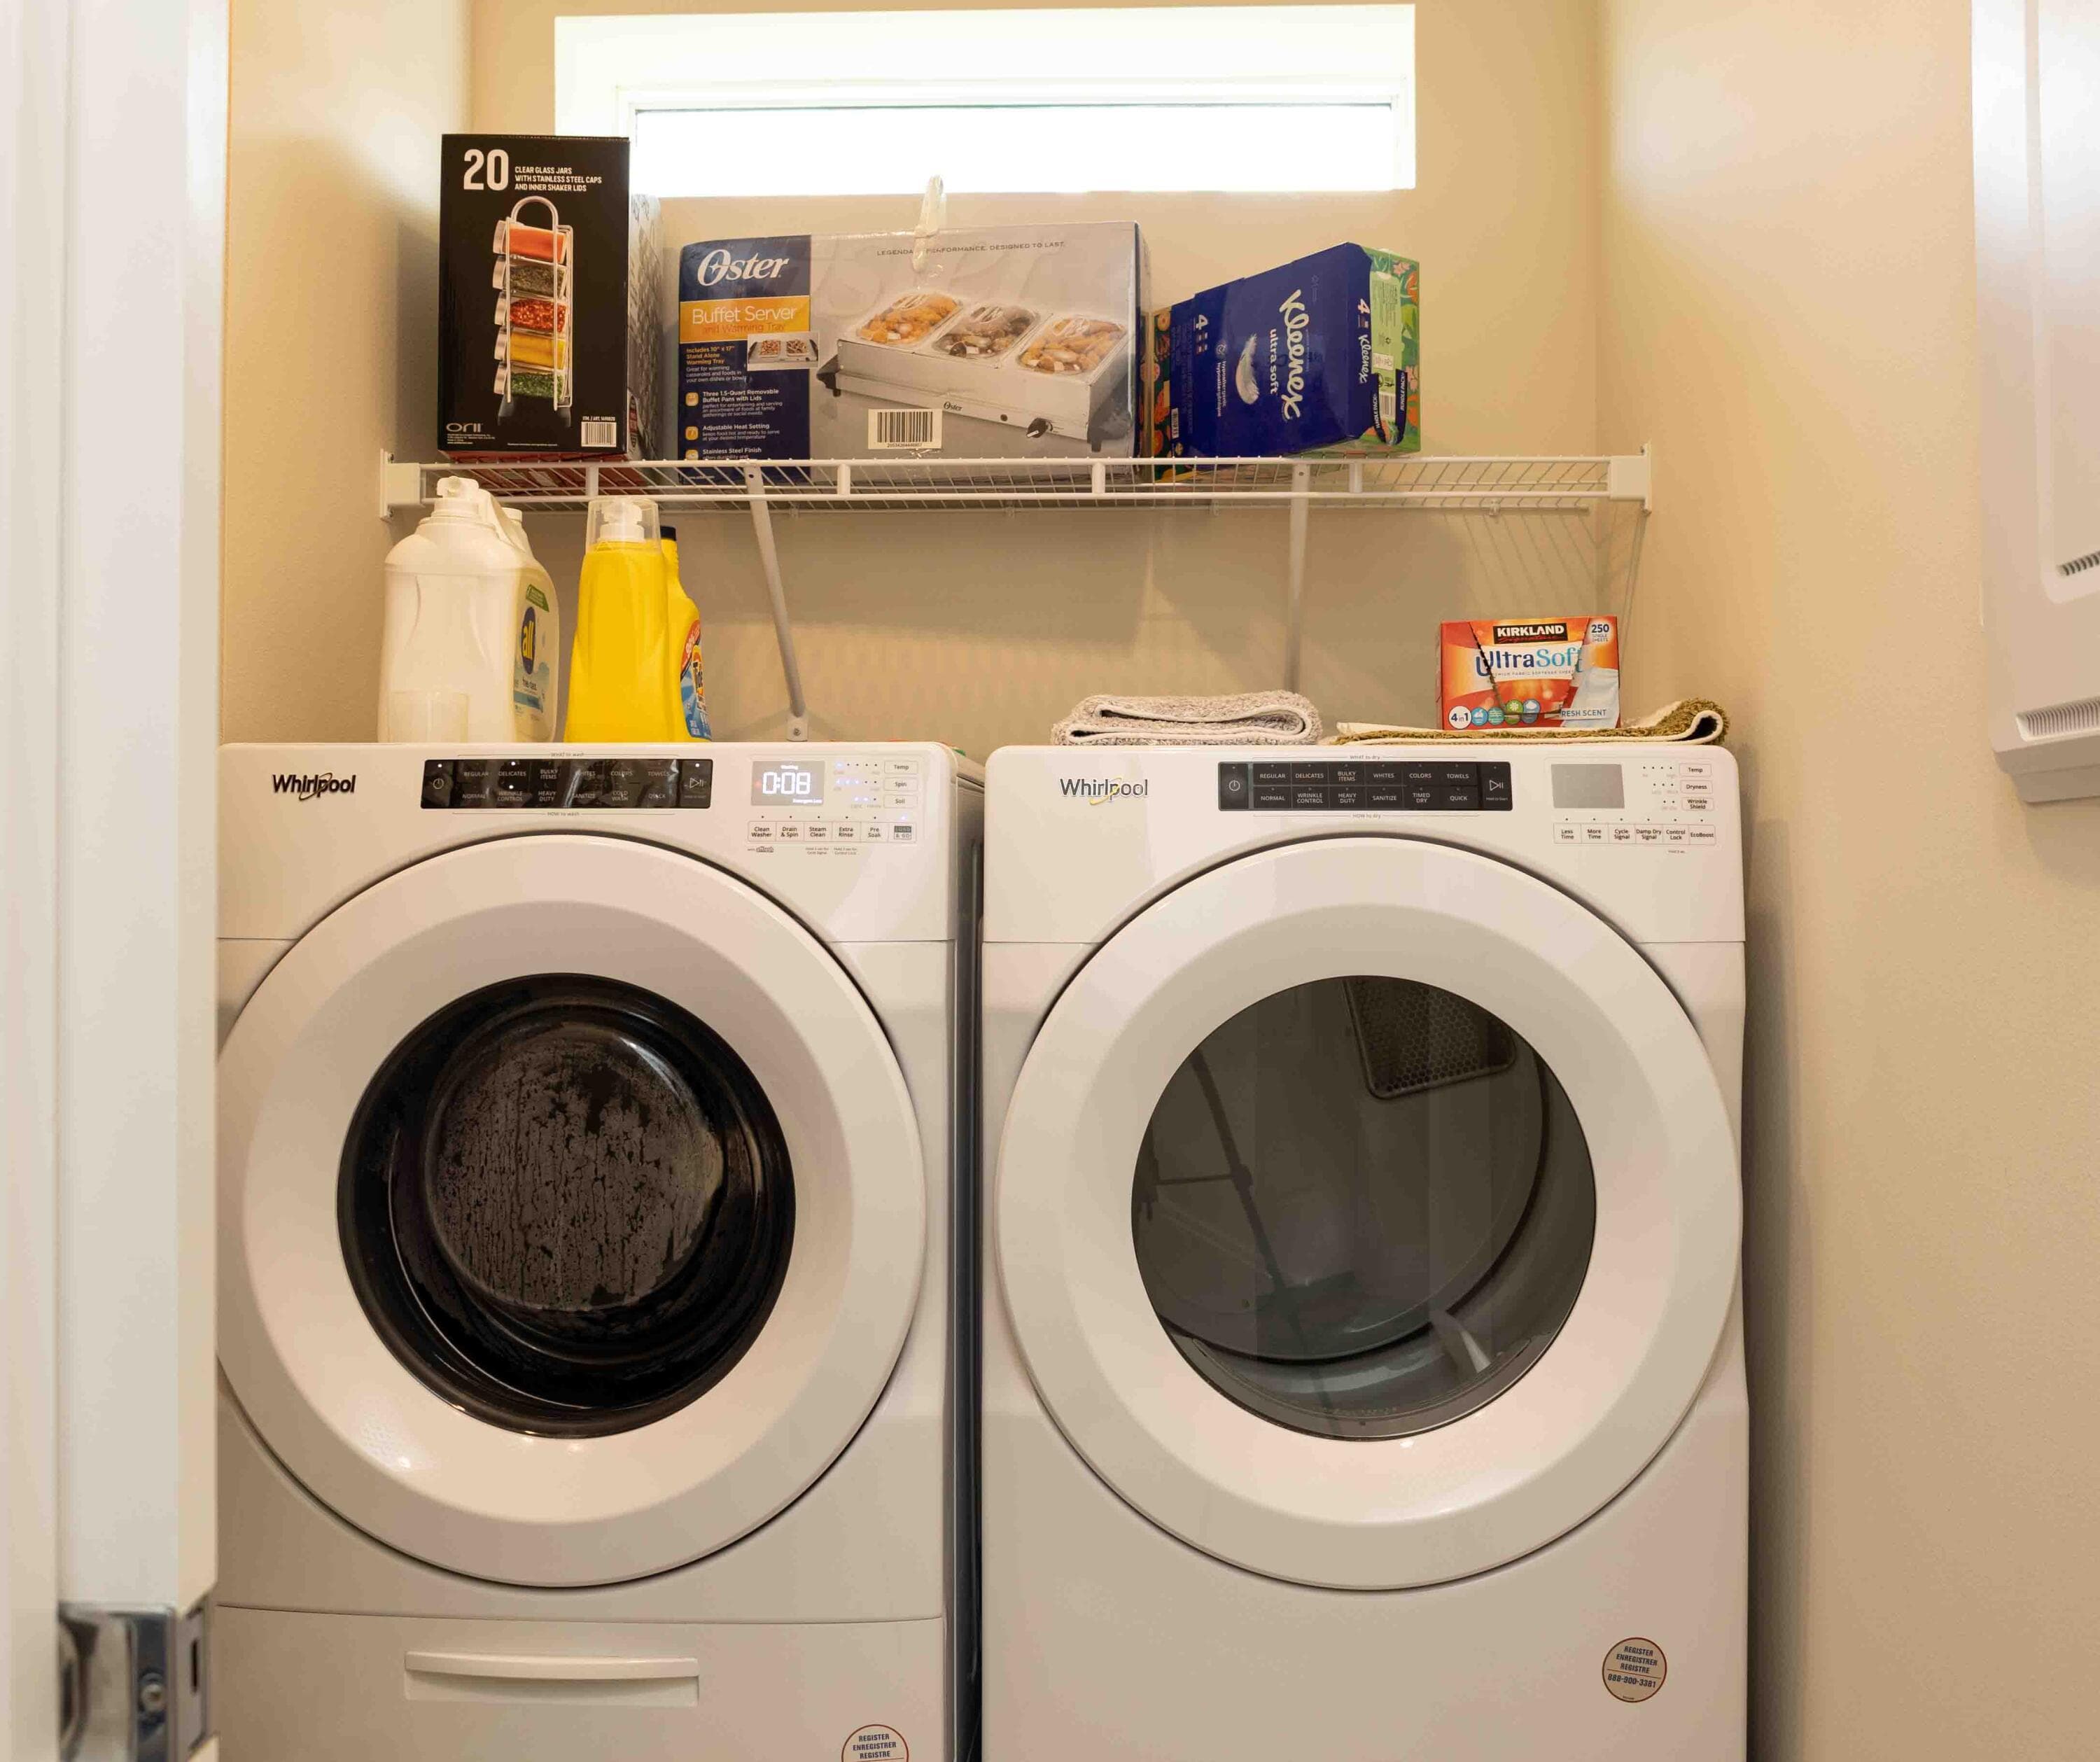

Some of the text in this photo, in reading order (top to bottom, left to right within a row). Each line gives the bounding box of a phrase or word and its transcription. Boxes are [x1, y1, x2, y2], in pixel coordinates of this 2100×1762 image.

[463, 148, 509, 190] 20
[697, 249, 790, 286] Oster
[1357, 298, 1371, 314] 4
[692, 306, 797, 324] Buffet Server
[1196, 314, 1208, 330] 4
[722, 324, 764, 335] Warming
[1269, 328, 1280, 395] ultra soft
[1279, 289, 1310, 420] Kleenex
[1358, 335, 1371, 384] Kleenex
[943, 401, 963, 412] Oster
[1497, 625, 1564, 637] KIRKLAND
[1591, 624, 1609, 634] 250
[522, 620, 534, 659] all
[272, 774, 356, 798] Whirlpool
[762, 771, 811, 795] 0:08
[1060, 778, 1149, 802] Whirlpool
[1624, 1646, 1653, 1656] REGISTER
[1616, 1653, 1658, 1666] ENREGISTRER
[1620, 1663, 1651, 1674] REGISTRE
[1607, 1673, 1656, 1688] 888-900-3381
[858, 1733, 890, 1742] REGISTER
[853, 1742, 897, 1751] ENREGISTRER
[860, 1751, 890, 1759] REGISTRE
